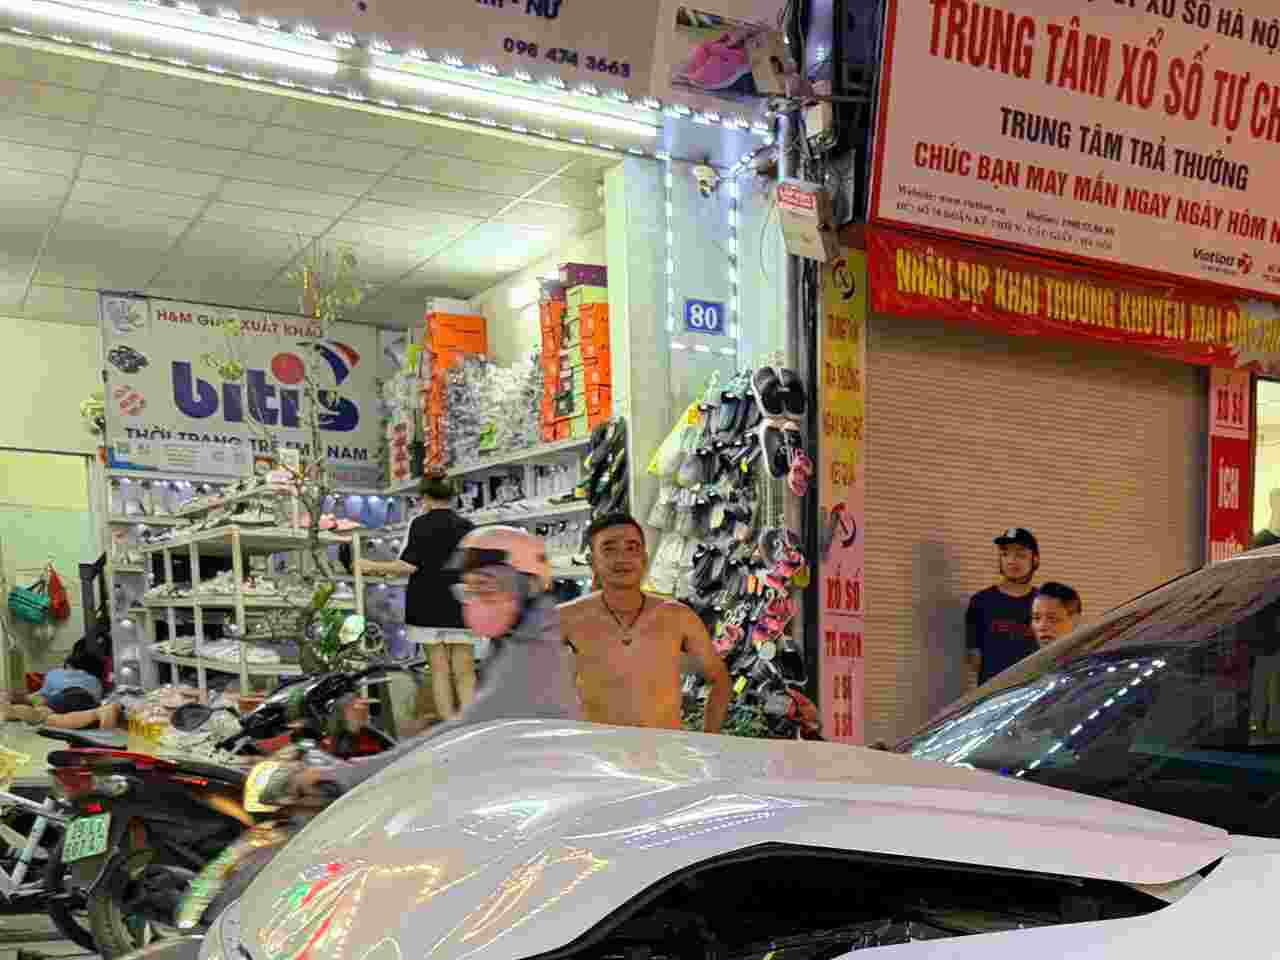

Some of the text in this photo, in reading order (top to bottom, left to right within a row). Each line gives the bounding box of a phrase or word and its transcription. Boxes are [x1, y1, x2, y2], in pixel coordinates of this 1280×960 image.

[1216, 8, 1245, 40] HÀ
[929, 0, 1035, 79] TRUNG
[1044, 16, 1110, 98] TÂM
[1115, 28, 1164, 110] XỔ
[1164, 42, 1210, 120] SỐ
[1211, 69, 1250, 143] TỰ
[999, 107, 1250, 191] TRUNG TÂM TRẢ THƯỞNG
[913, 141, 971, 177] CHÚC
[977, 158, 1020, 190] BẠN
[1025, 167, 1069, 197] MAY
[1073, 171, 1119, 208] MẮN
[1123, 185, 1171, 217] NGAY
[1176, 193, 1223, 231] NGÀY
[1227, 204, 1265, 242] HÔM
[689, 303, 718, 330] 80
[895, 247, 953, 300] NHÂN
[956, 260, 990, 312] DỊP
[994, 267, 1040, 315] KHAI
[1120, 285, 1185, 338] KHUYẾN
[326, 445, 368, 461] NAM
